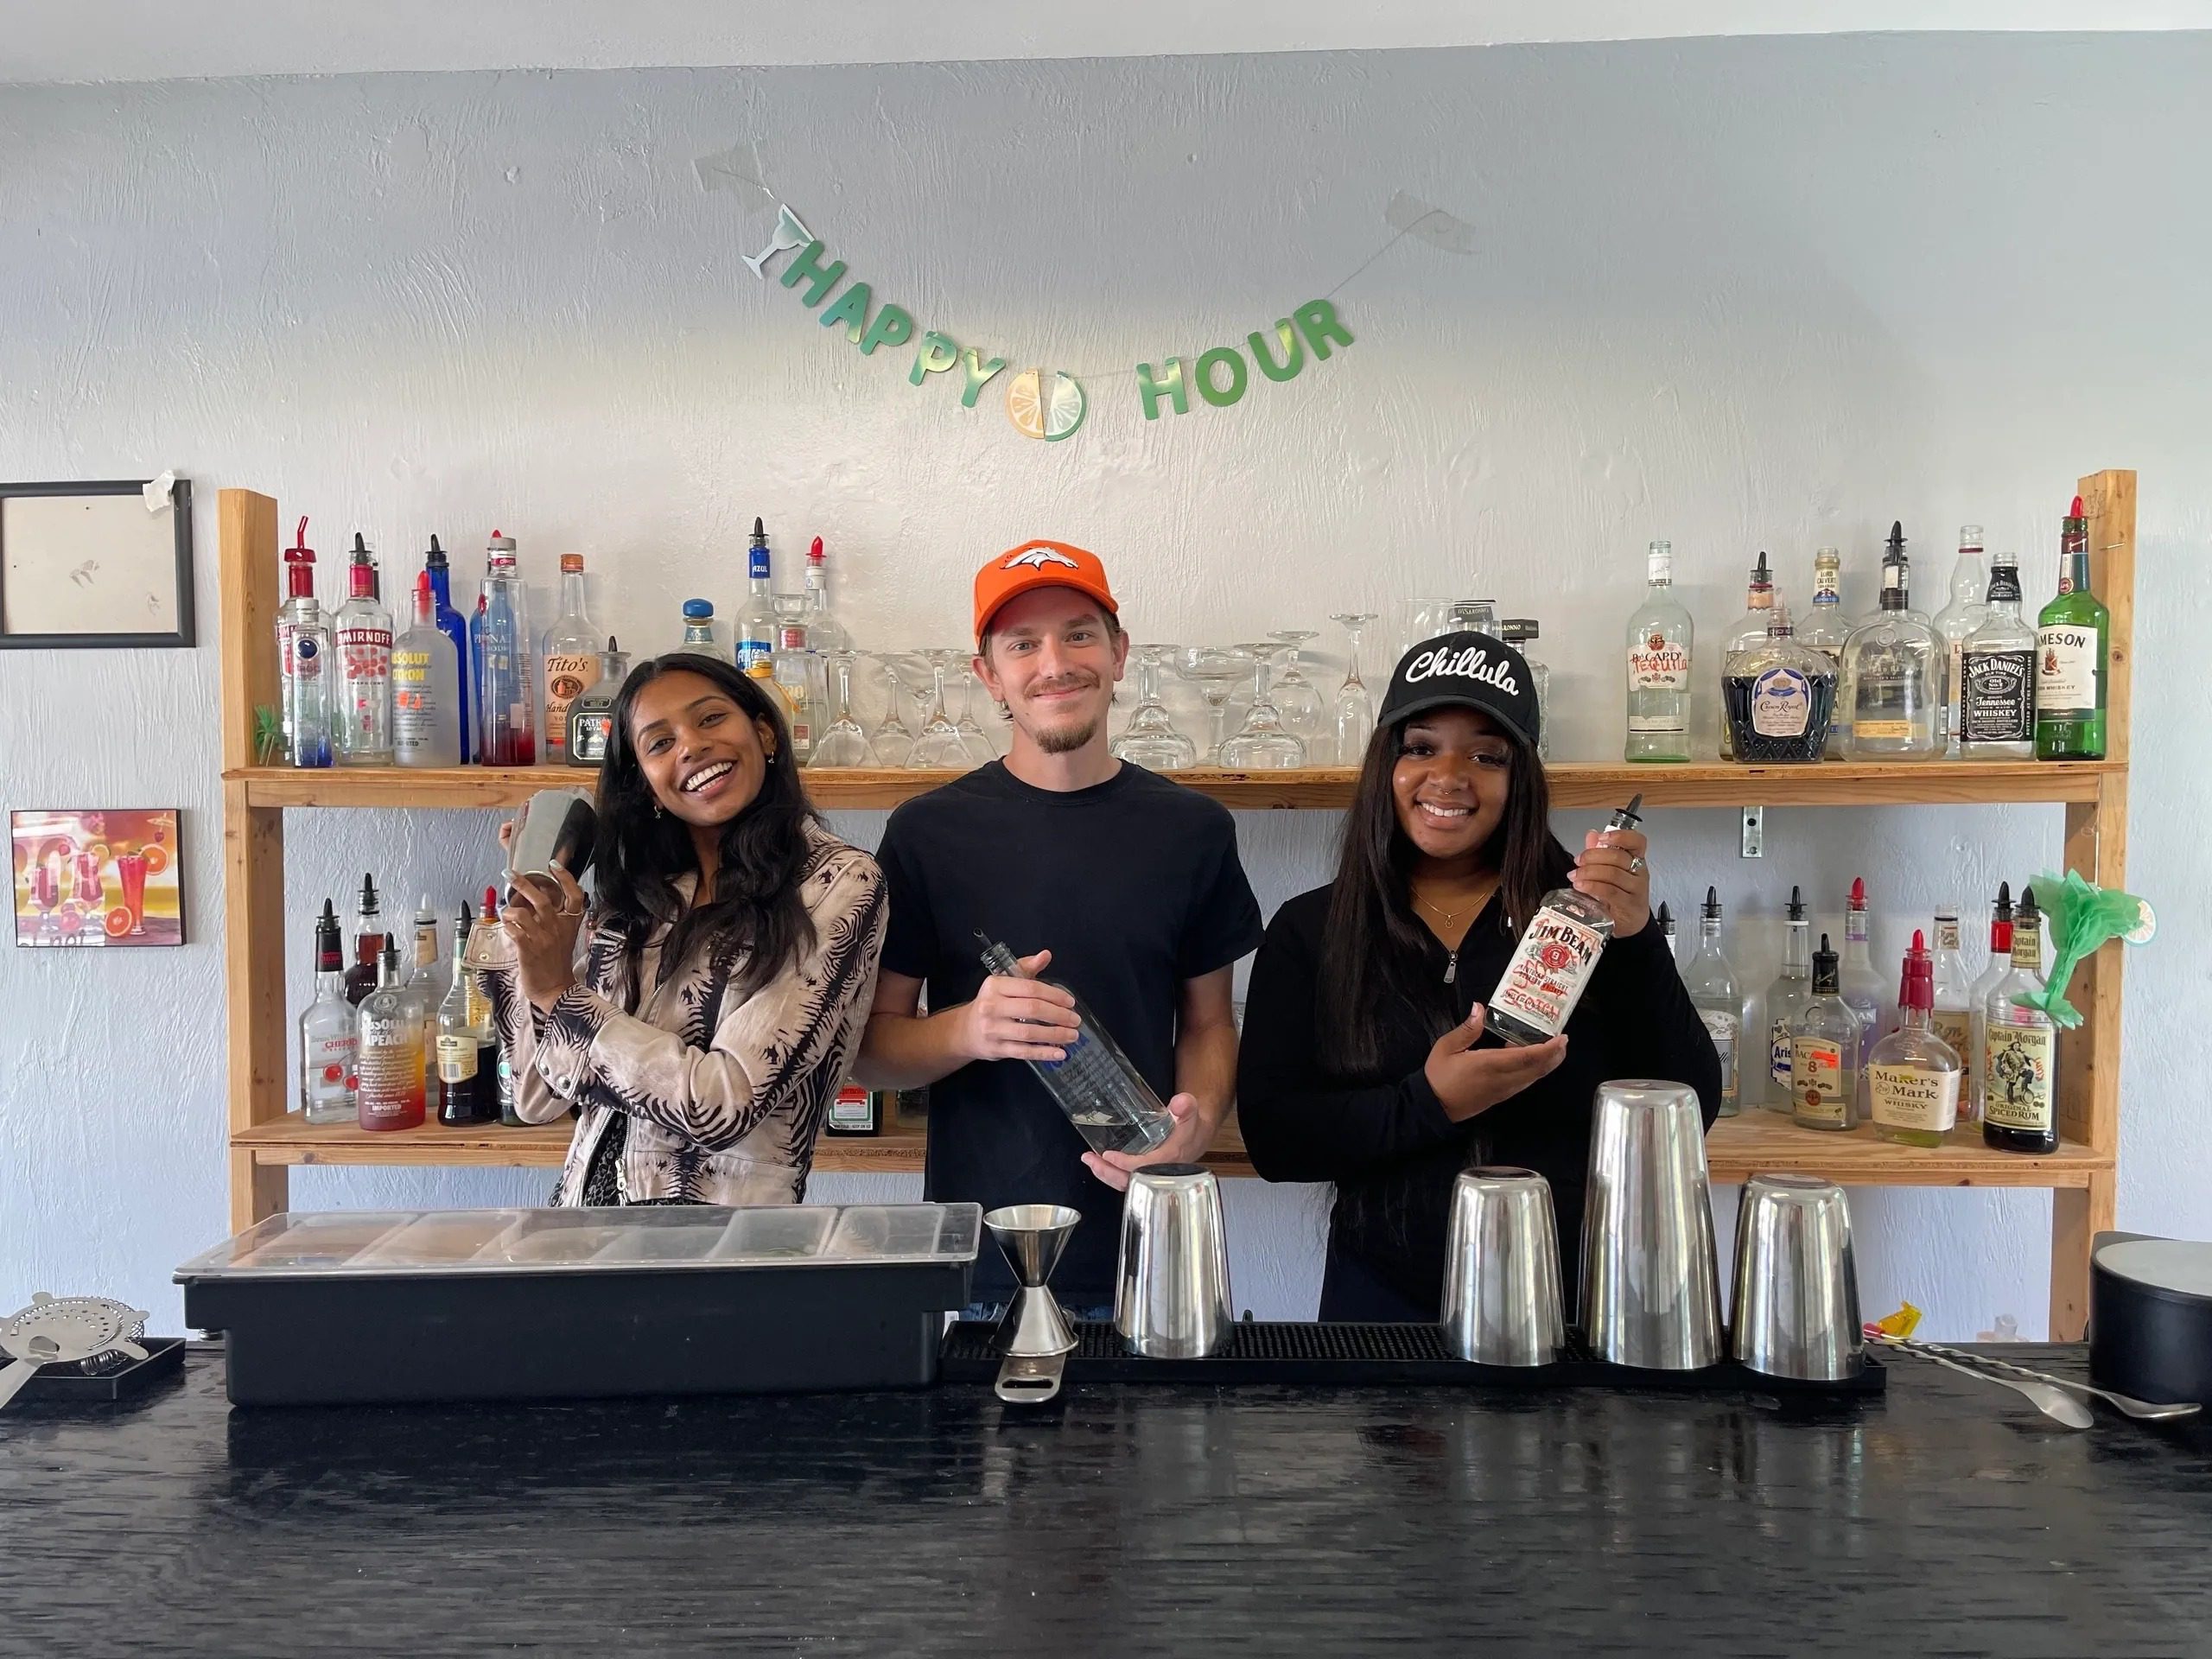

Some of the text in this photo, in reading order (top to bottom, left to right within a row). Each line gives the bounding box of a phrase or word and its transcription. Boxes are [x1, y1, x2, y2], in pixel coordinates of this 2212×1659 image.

[780, 240, 1354, 420] HAPPY HOUR
[337, 631, 391, 645] SMIRNOFF
[2038, 632, 2086, 648] AMESON
[391, 653, 429, 664] BSOLUT
[547, 657, 588, 672] Tito's
[1405, 646, 1519, 696] Chillula
[1968, 658, 2025, 677] JACK DANIEL'S
[546, 701, 570, 713] Hand
[1975, 696, 2016, 706] Tennessee
[579, 718, 602, 727] PATR
[1529, 923, 1562, 940] JIM
[1560, 925, 1592, 966] BEAM
[1988, 1027, 2046, 1046] Captain Morgan
[1808, 1061, 1817, 1072] 8
[1891, 1085, 1939, 1100] Mark
[1884, 1098, 1928, 1109] WHISKY
[1995, 1101, 2031, 1111] ORIGINAL
[1989, 1105, 2039, 1121] SPICED RUM
